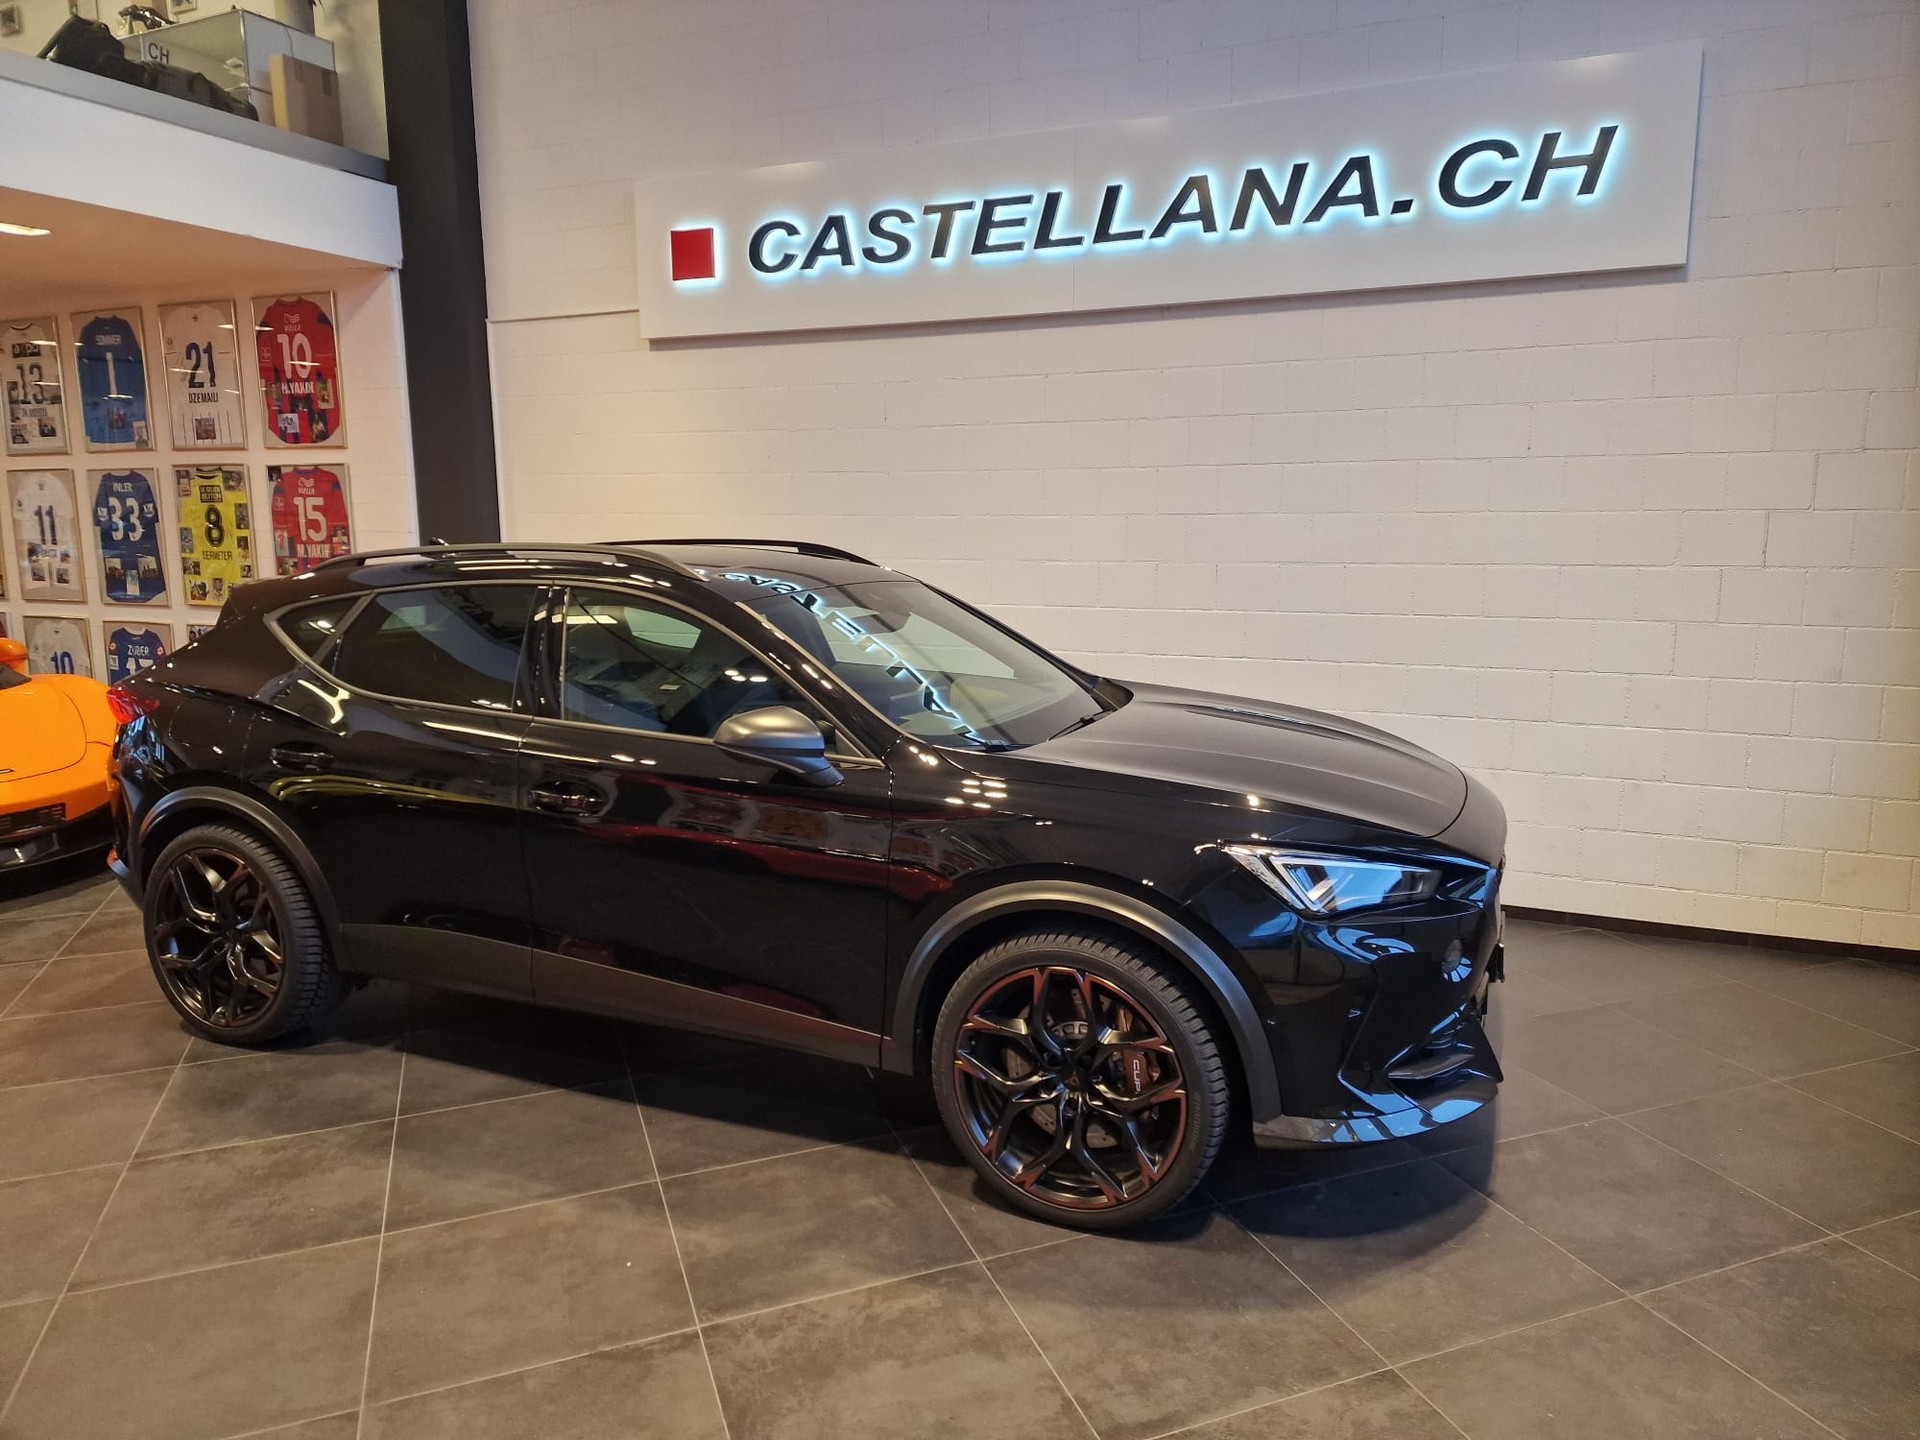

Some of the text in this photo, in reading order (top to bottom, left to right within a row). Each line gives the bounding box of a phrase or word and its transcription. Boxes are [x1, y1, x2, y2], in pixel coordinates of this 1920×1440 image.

[148, 42, 169, 64] CH
[105, 352, 118, 397] 1
[185, 341, 216, 388] 21
[277, 332, 312, 379] 10
[16, 363, 44, 405] 13
[113, 482, 133, 493] INLER
[34, 504, 58, 545] 11
[108, 496, 142, 542] 33
[204, 504, 225, 548] 8
[293, 496, 327, 542] 15
